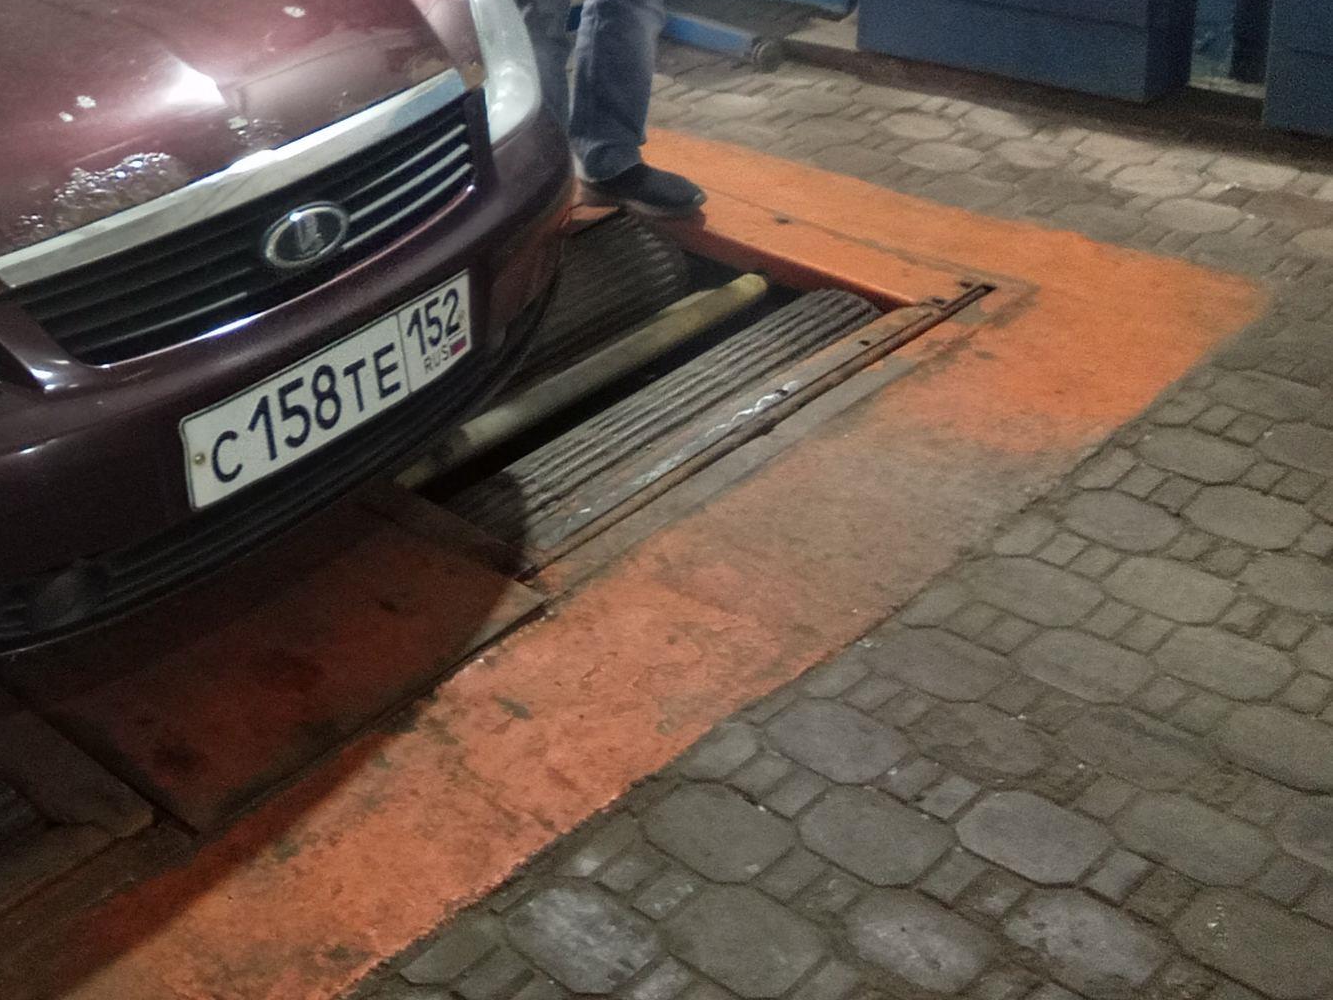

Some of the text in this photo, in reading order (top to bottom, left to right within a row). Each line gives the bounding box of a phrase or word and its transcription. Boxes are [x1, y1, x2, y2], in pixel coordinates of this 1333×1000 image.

[211, 288, 461, 483] С158ТЕ 152
[424, 344, 449, 373] RUS
